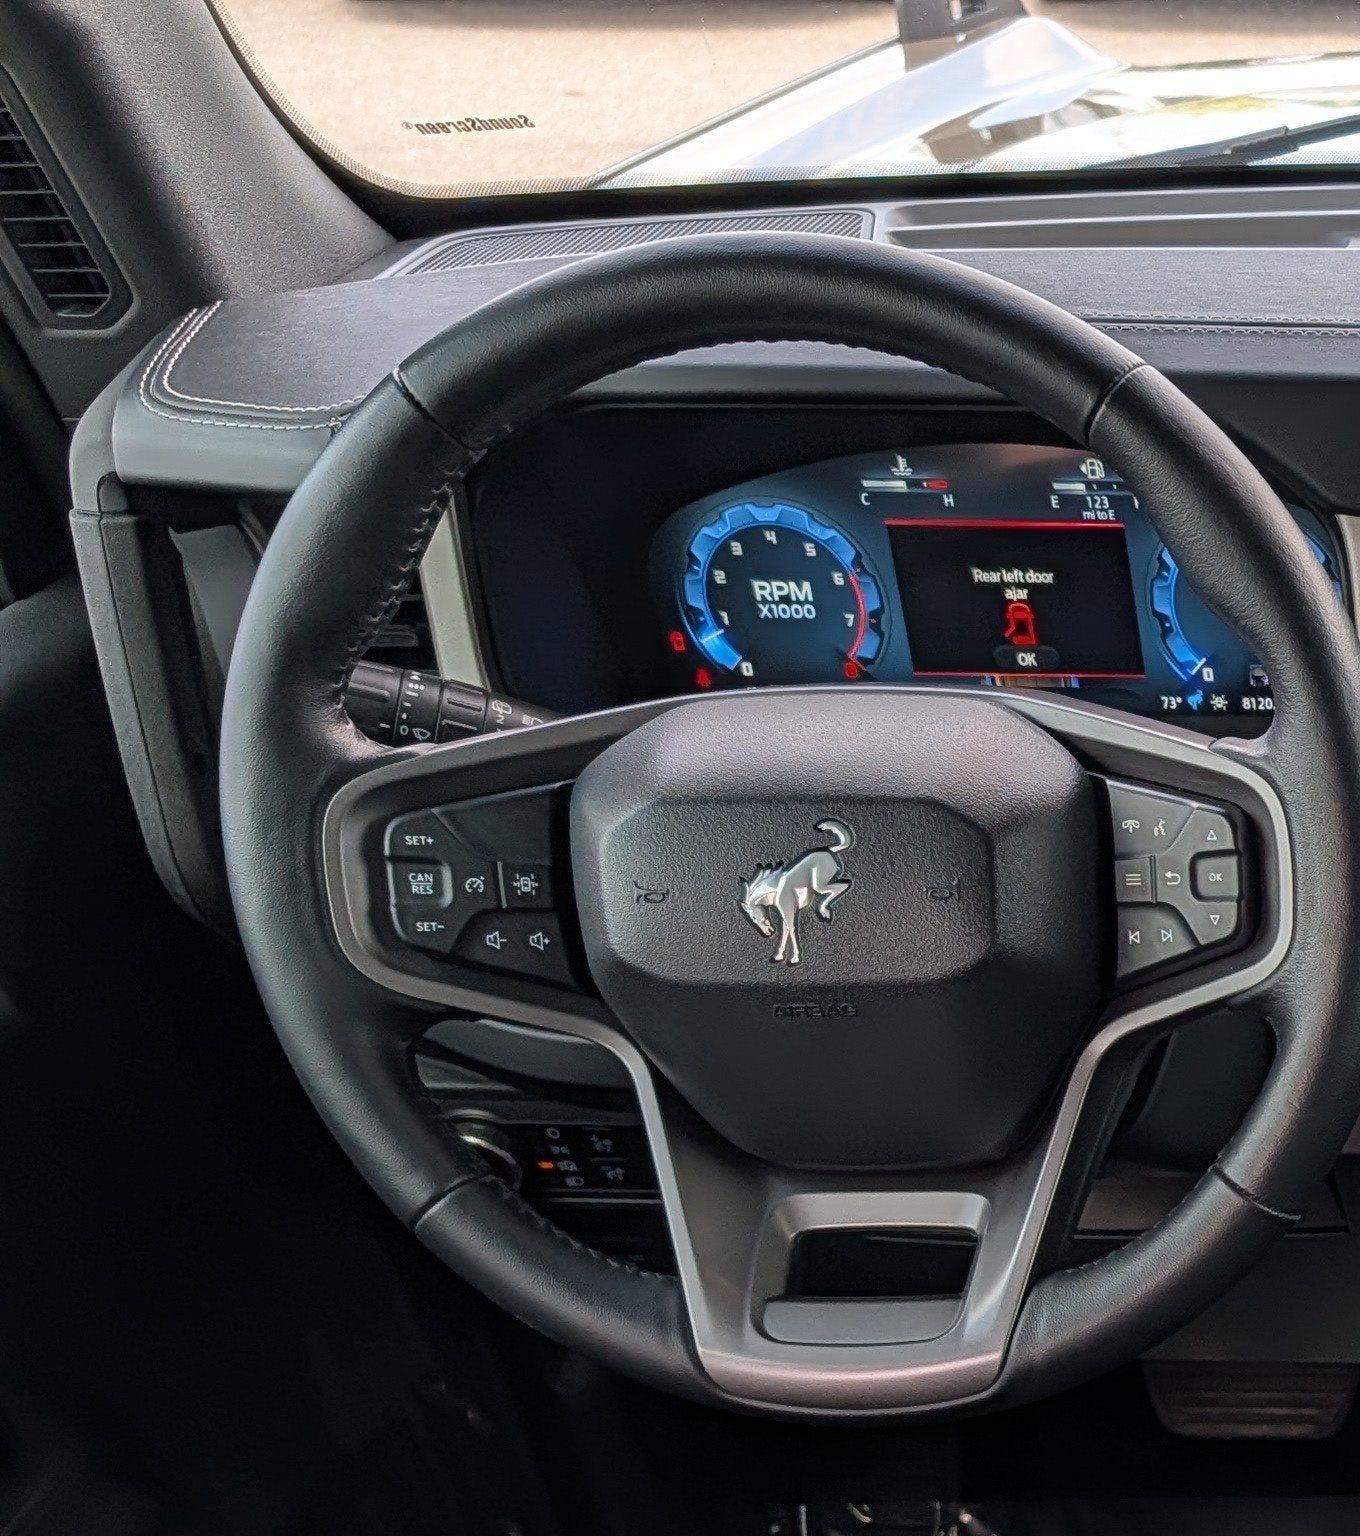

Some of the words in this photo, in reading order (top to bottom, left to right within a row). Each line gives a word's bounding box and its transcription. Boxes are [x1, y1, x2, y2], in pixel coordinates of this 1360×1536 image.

[860, 492, 871, 506] C
[942, 493, 954, 508] H
[1050, 495, 1060, 509] E
[1086, 496, 1110, 509] 123
[1109, 510, 1116, 520] E
[763, 530, 778, 544] 4
[730, 541, 743, 556] 3
[803, 543, 817, 557] 5
[713, 569, 727, 585] 2
[832, 572, 845, 586] 6
[971, 567, 1001, 584] Rear
[1001, 567, 1024, 583] left
[1025, 568, 1054, 584] door
[752, 580, 814, 602] RPM
[1004, 587, 1029, 601] ajar
[758, 603, 817, 620] X1000
[844, 613, 855, 627] 7
[1016, 652, 1038, 667] OK
[740, 661, 754, 677] 0
[408, 872, 434, 883] CAN
[1208, 872, 1223, 883] OK
[411, 884, 434, 895] RES
